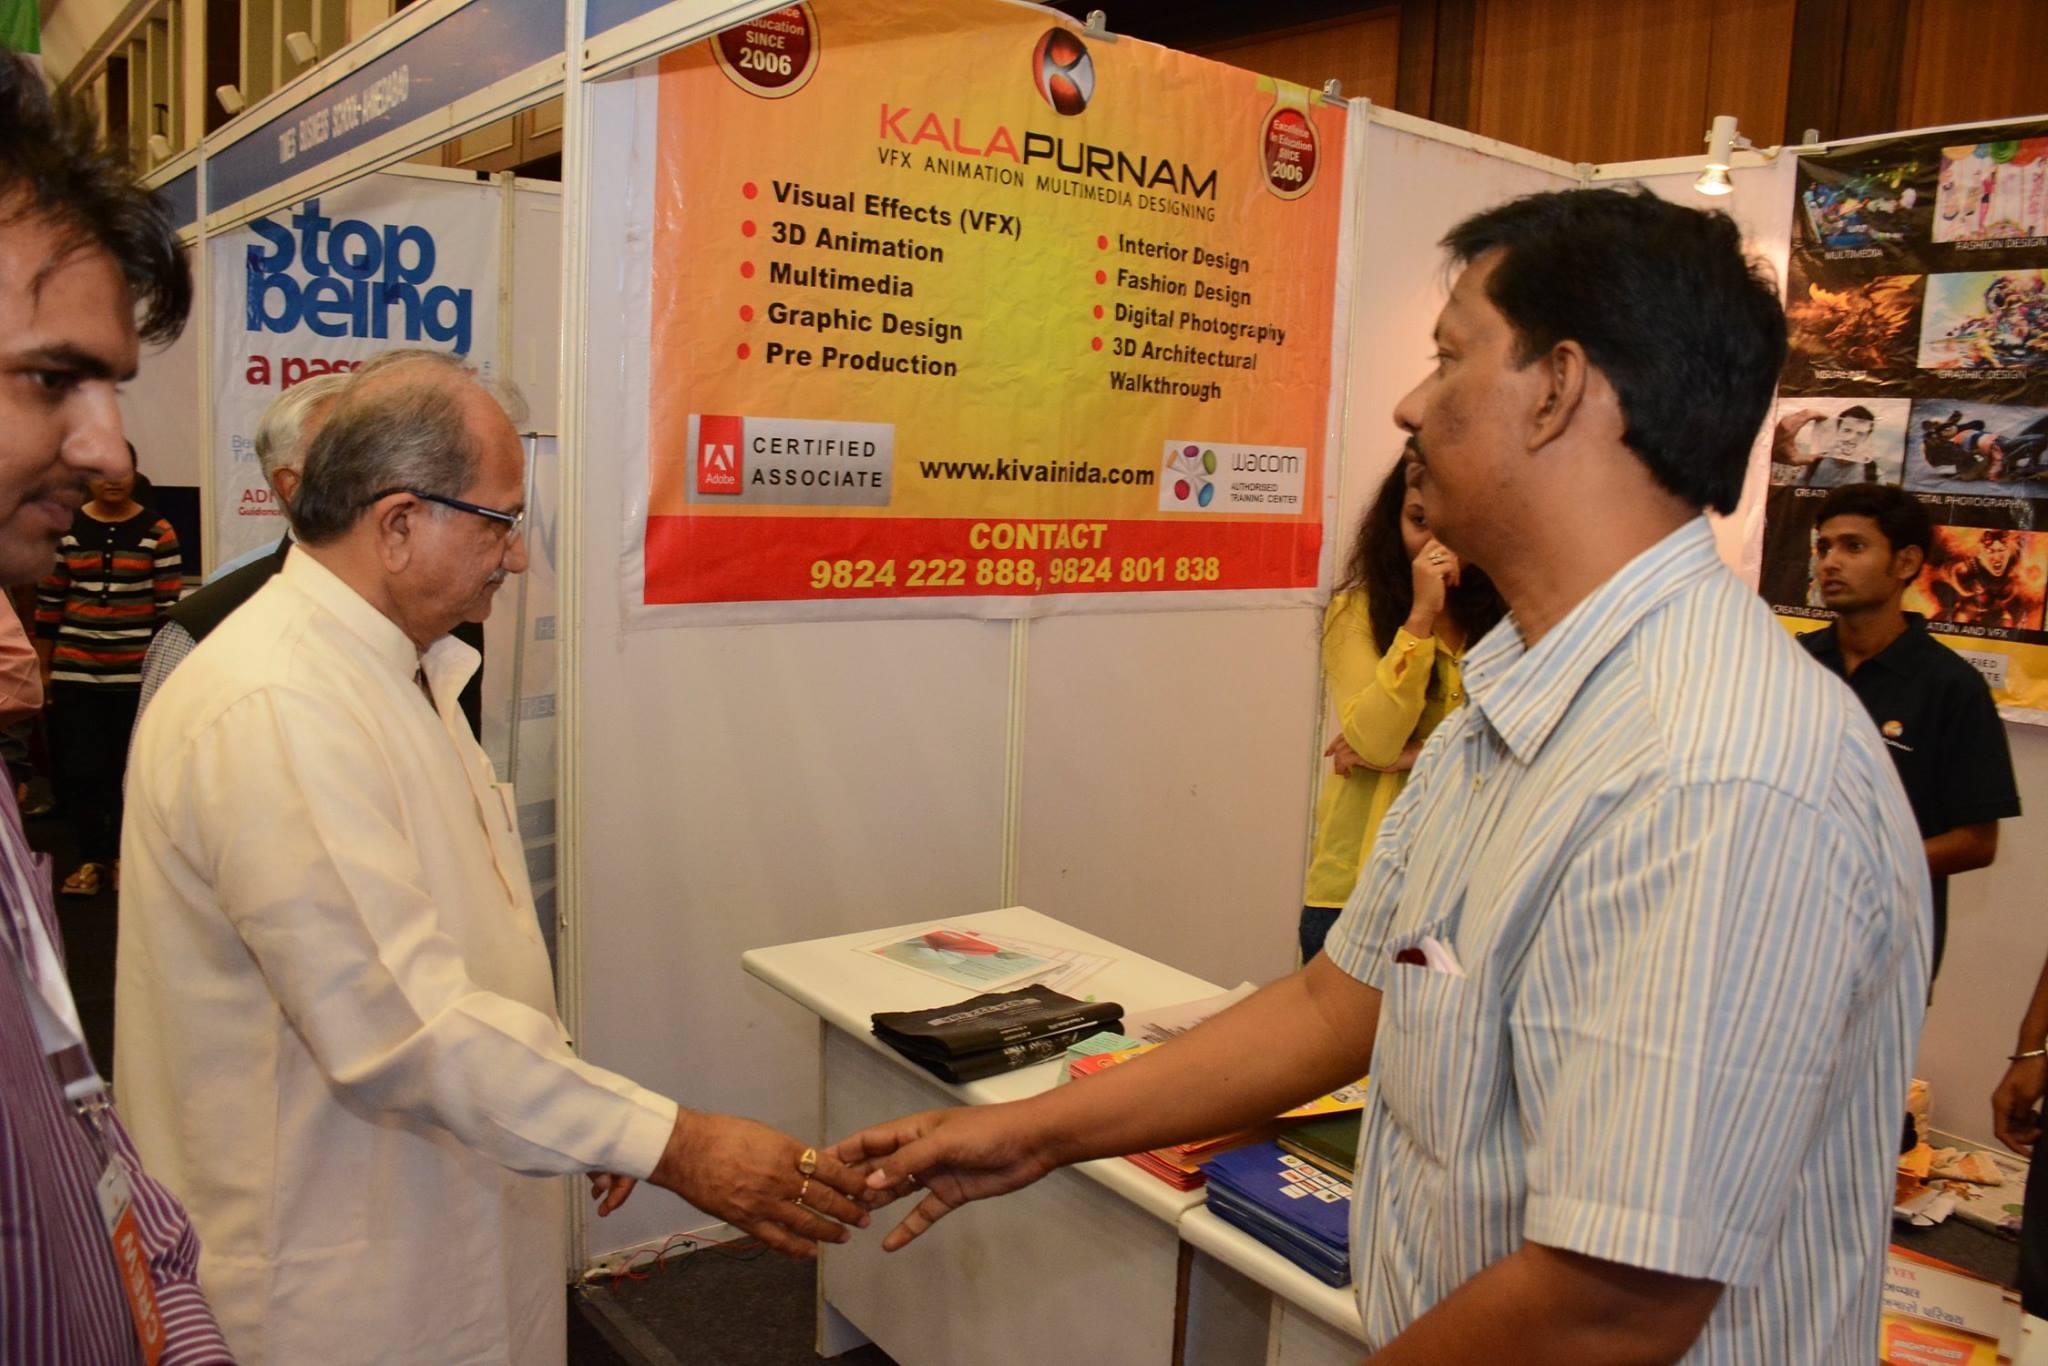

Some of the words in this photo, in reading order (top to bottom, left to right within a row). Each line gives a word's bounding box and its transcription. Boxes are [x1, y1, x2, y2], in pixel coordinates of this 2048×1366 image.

[744, 19, 805, 36] ducation
[745, 30, 785, 49] SINCE
[739, 47, 792, 76] 2006
[879, 103, 1217, 200] KALAPURNAM
[1279, 147, 1300, 162] SINCE
[878, 147, 912, 168] VFX
[924, 156, 1024, 187] ANIMATION
[1037, 175, 1132, 207] MULTIMEDIA
[1139, 194, 1215, 222] DESIGNING
[1271, 161, 1303, 182] 2006
[772, 180, 855, 212] Visual
[864, 194, 952, 226] Effects
[960, 208, 1021, 241] (VFX)
[247, 198, 436, 304] Stop
[771, 221, 806, 245] 3D
[815, 227, 943, 262] Animation
[1119, 233, 1188, 262] Interior
[1193, 247, 1250, 275] Design
[770, 261, 914, 298] Multimedia
[1117, 268, 1187, 296] Fashion
[1194, 280, 1251, 308] Design
[246, 245, 473, 358] being
[767, 302, 872, 333] Graphic
[882, 313, 963, 344] Design
[1115, 303, 1174, 328] Digital
[1180, 311, 1286, 345] Photography
[246, 355, 271, 385] a
[766, 342, 812, 366] Pre
[822, 347, 957, 377] Production
[1113, 336, 1136, 357] 3D
[1141, 341, 1257, 370] Architectural
[1110, 371, 1221, 402] Walkthrough
[753, 436, 876, 458] CERTIFIED
[1232, 452, 1299, 473] wacom
[705, 472, 736, 485] Adobe
[751, 468, 883, 488] ASSOCIATE
[1230, 493, 1264, 503] TRAINING
[969, 522, 1108, 550] CONTACT
[810, 559, 896, 589] 9824
[905, 559, 967, 587] 222
[975, 558, 1043, 591] 888,
[1049, 556, 1112, 584] 9824
[1119, 556, 1166, 582] 801
[1174, 556, 1220, 582] 838
